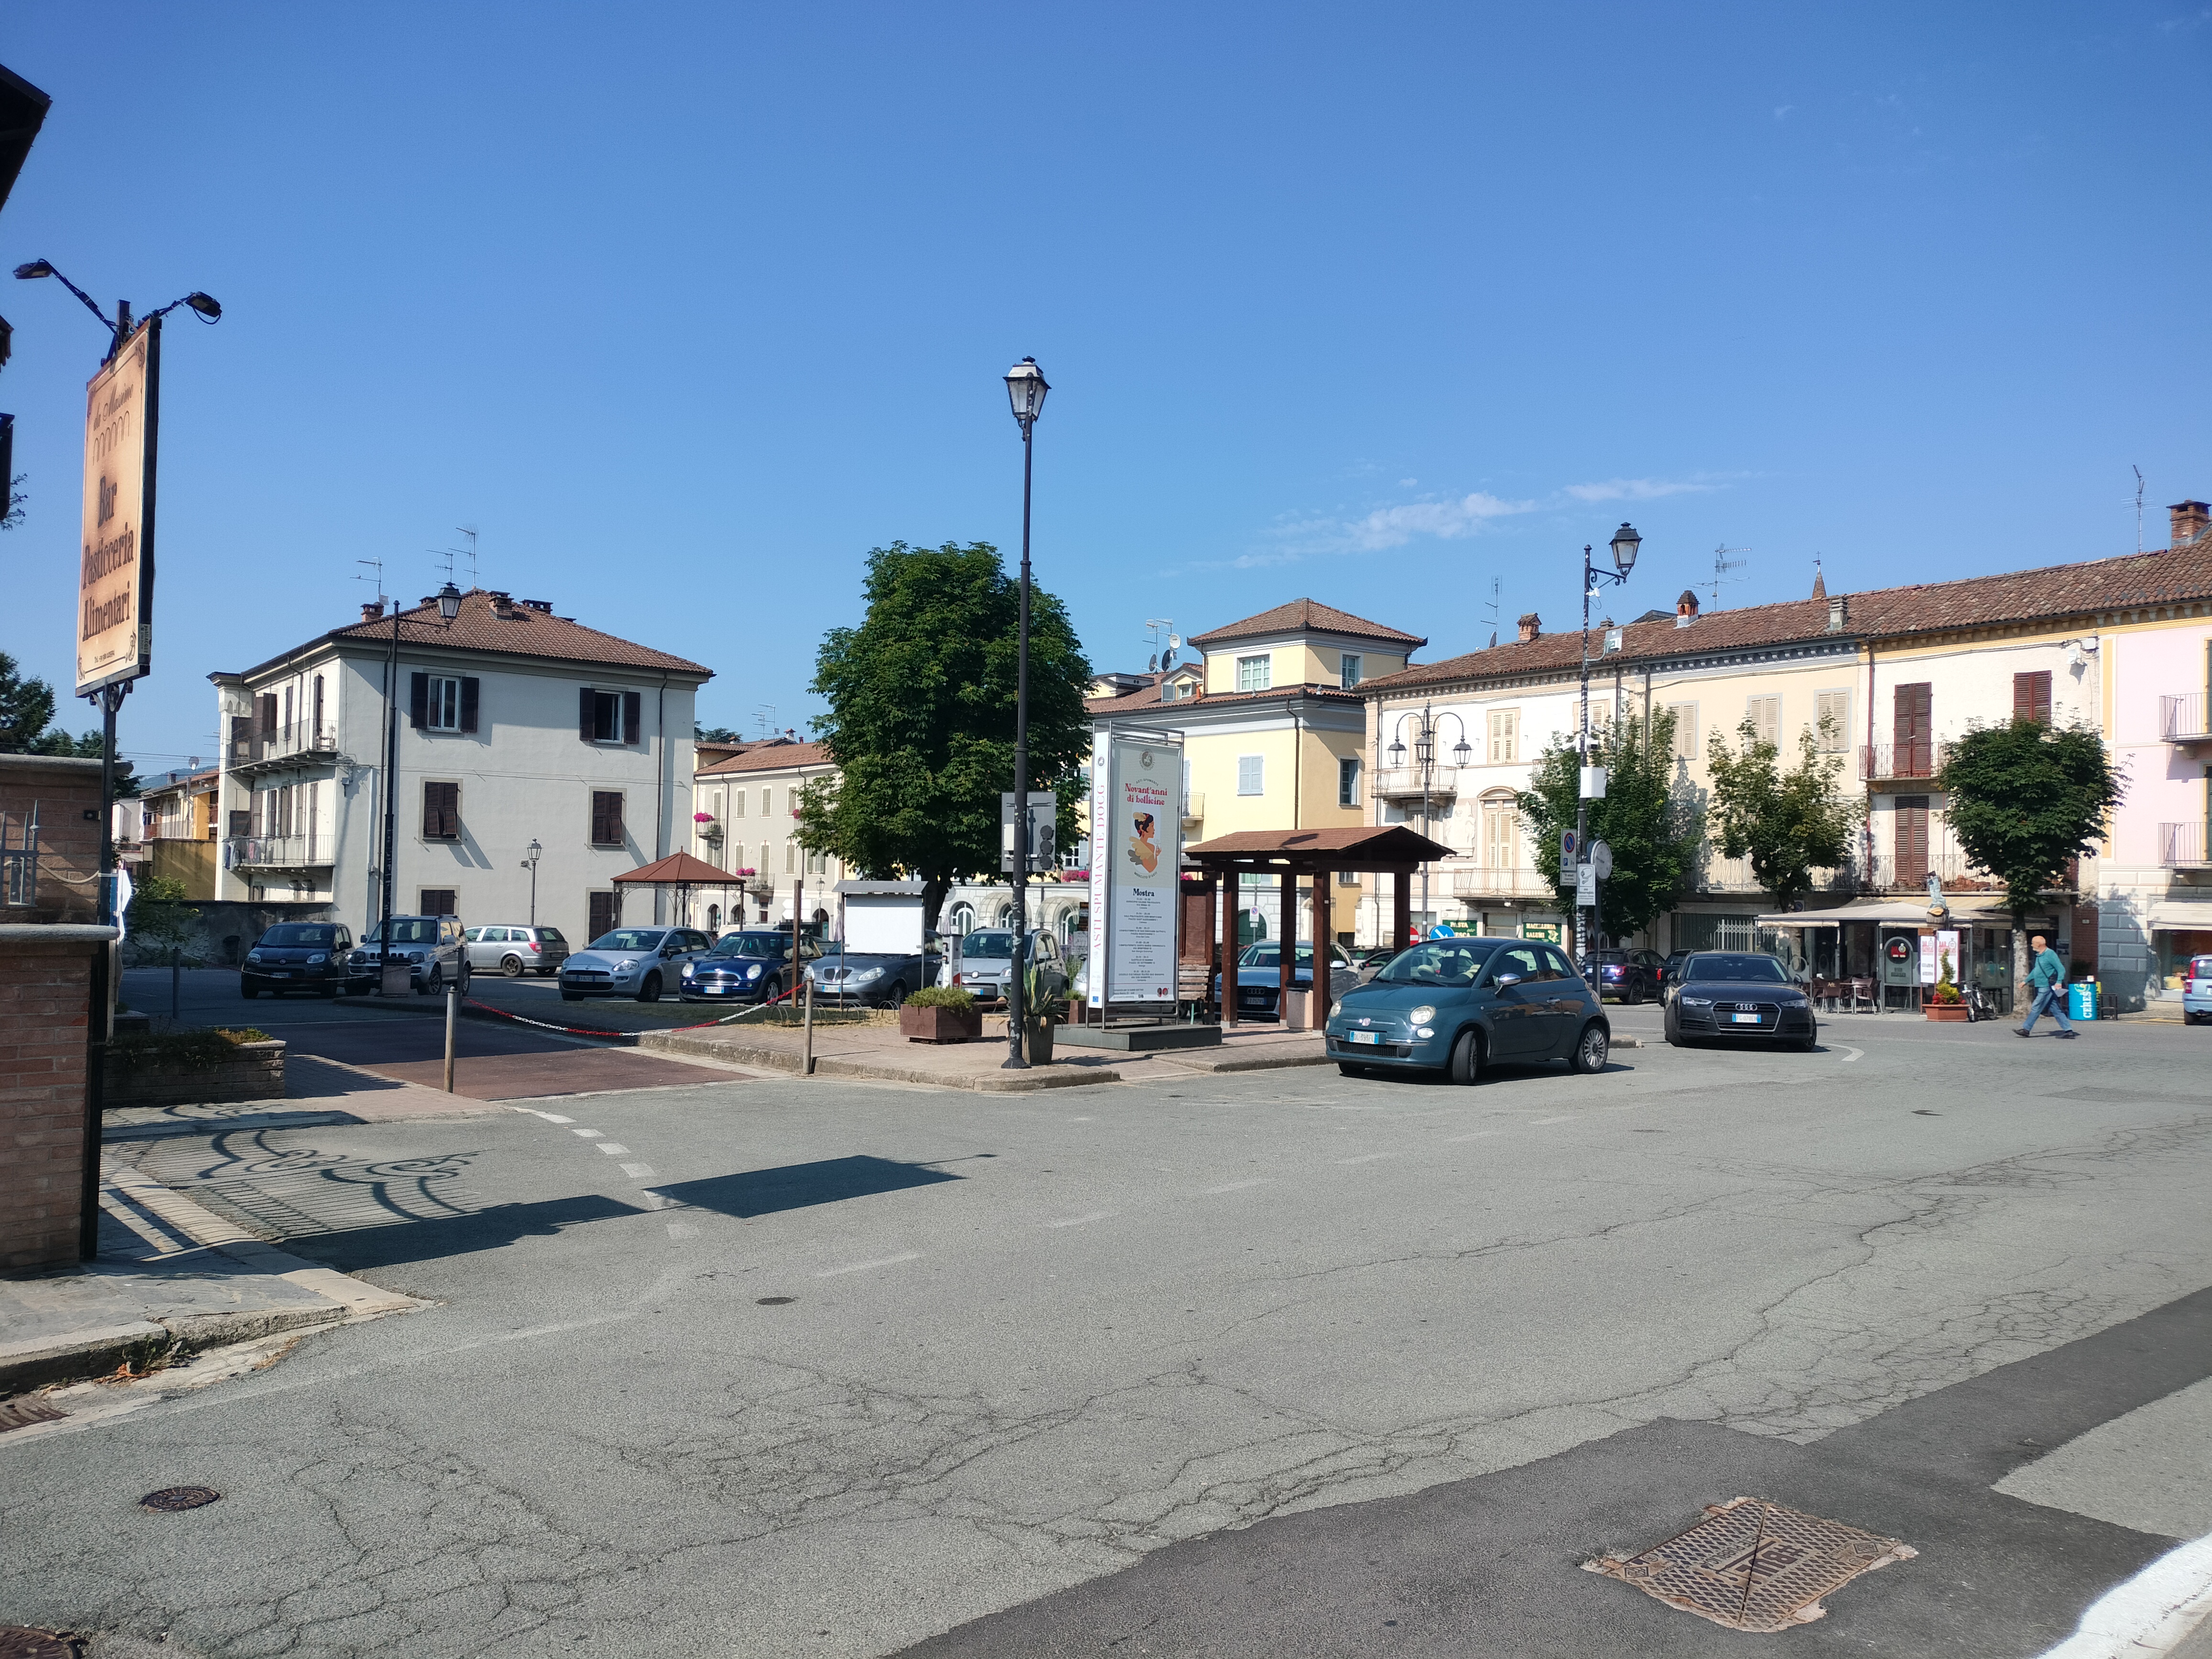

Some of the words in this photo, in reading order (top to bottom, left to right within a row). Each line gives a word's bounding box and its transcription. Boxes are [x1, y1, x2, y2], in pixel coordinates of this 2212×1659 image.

[93, 402, 101, 431] da
[102, 383, 133, 421] Massimo
[97, 476, 117, 529] Bar
[83, 521, 134, 590] Pasticceria
[82, 580, 130, 642] Alimentari
[1125, 783, 1168, 796] Novant'anni
[1143, 778, 1159, 786] SPUMANTE
[1096, 785, 1105, 828] DOCG
[1127, 794, 1134, 803] di
[1136, 794, 1165, 806] bollicine
[1094, 832, 1105, 914] SPUMANTE
[1133, 888, 1155, 897] Mostra
[2079, 991, 2092, 1018] CERES
[1360, 1033, 1374, 1042] 393FL
